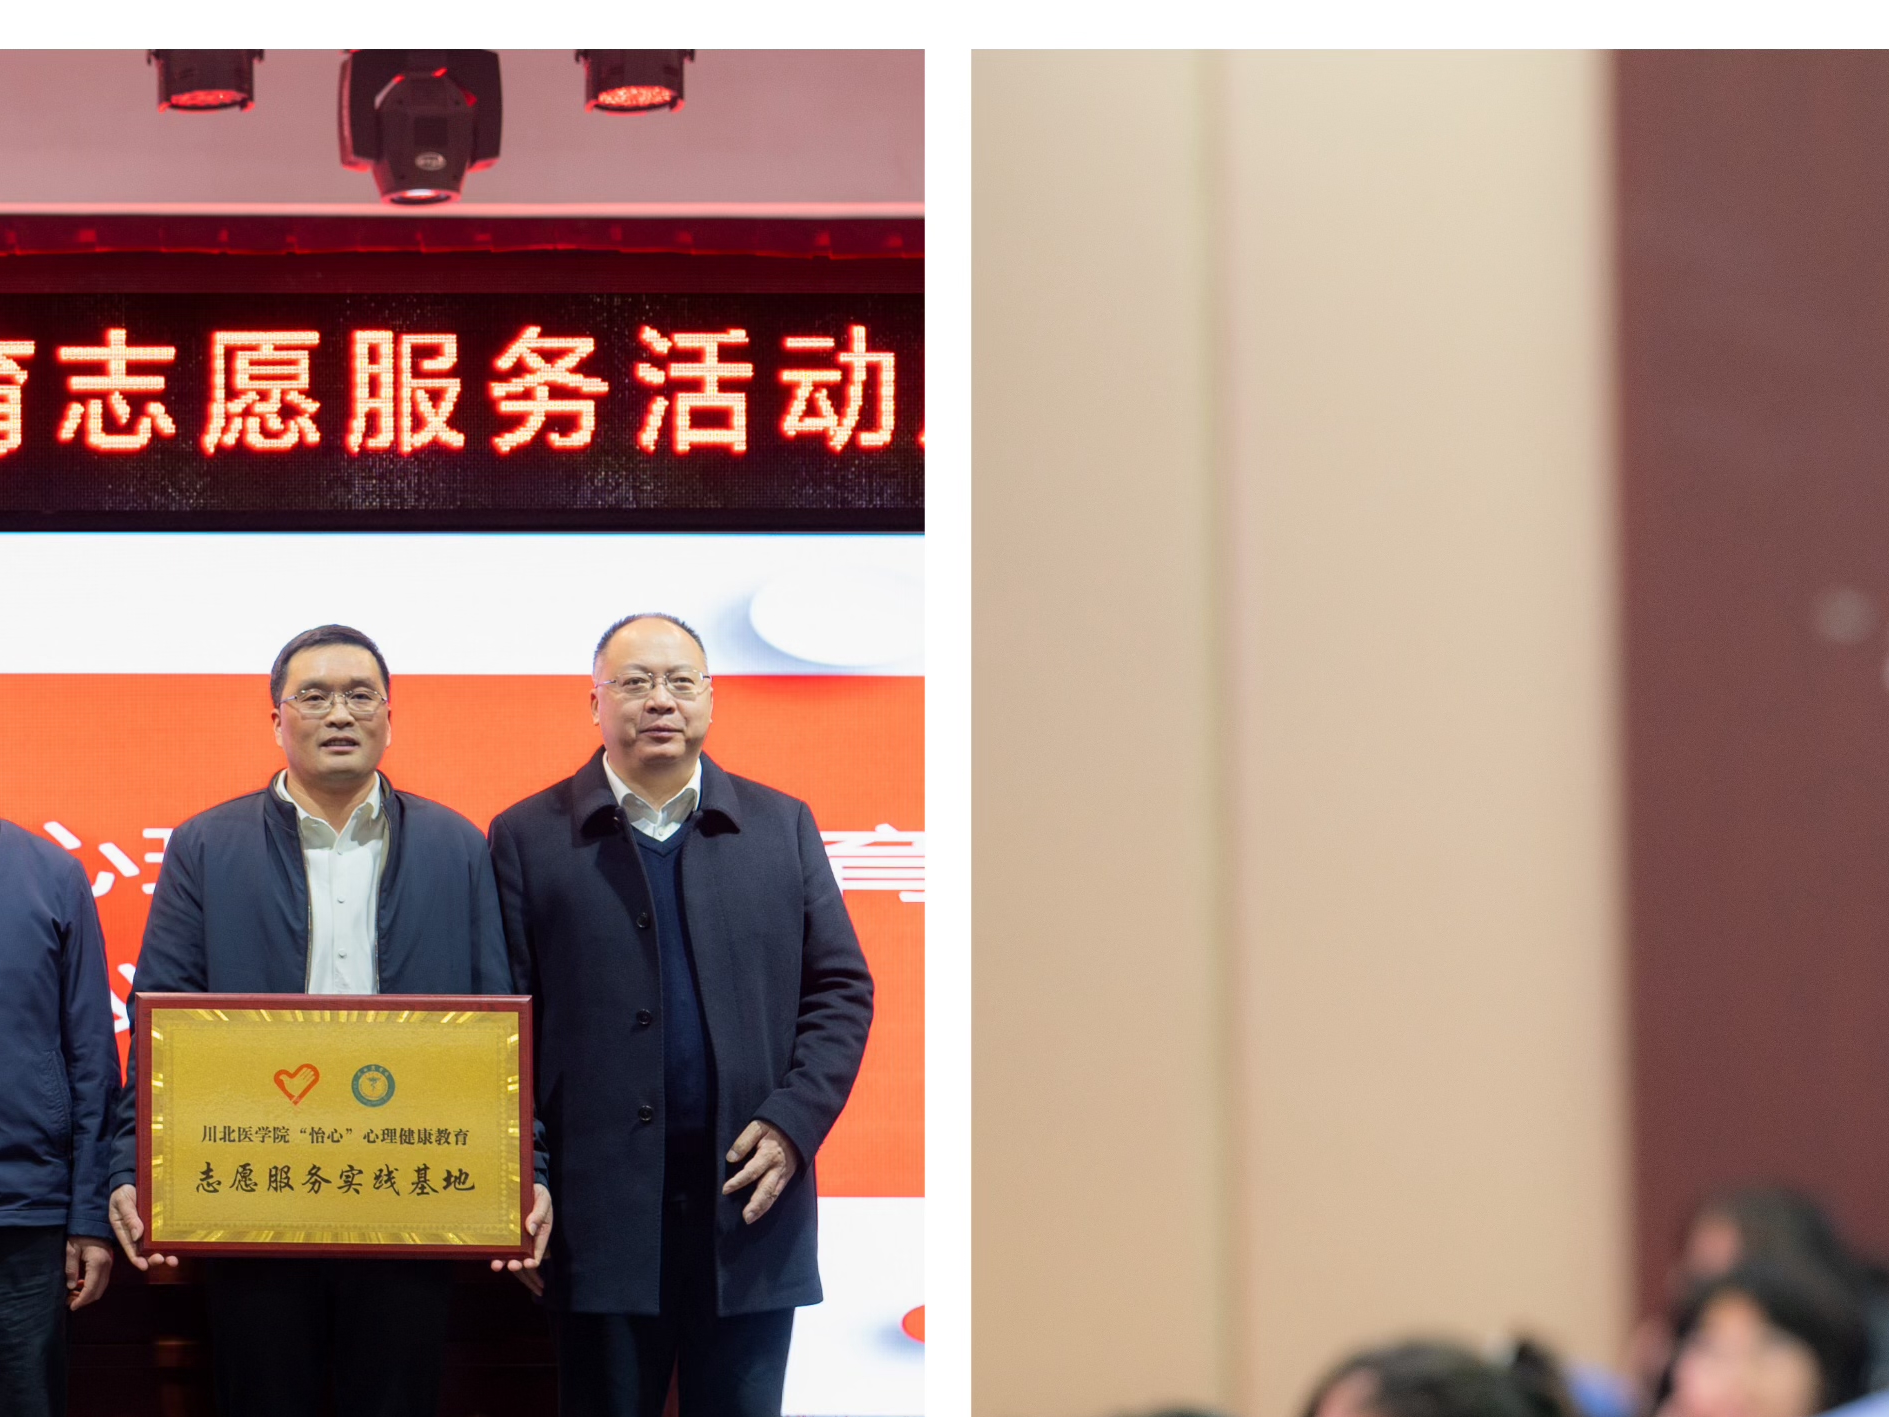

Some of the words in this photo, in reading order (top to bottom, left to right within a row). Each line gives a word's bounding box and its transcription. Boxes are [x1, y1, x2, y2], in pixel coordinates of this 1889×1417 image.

[202, 1125, 470, 1147] 川北医学院“怡心”心理健康教育
[196, 1161, 476, 1196] 志愿服务实践基地
